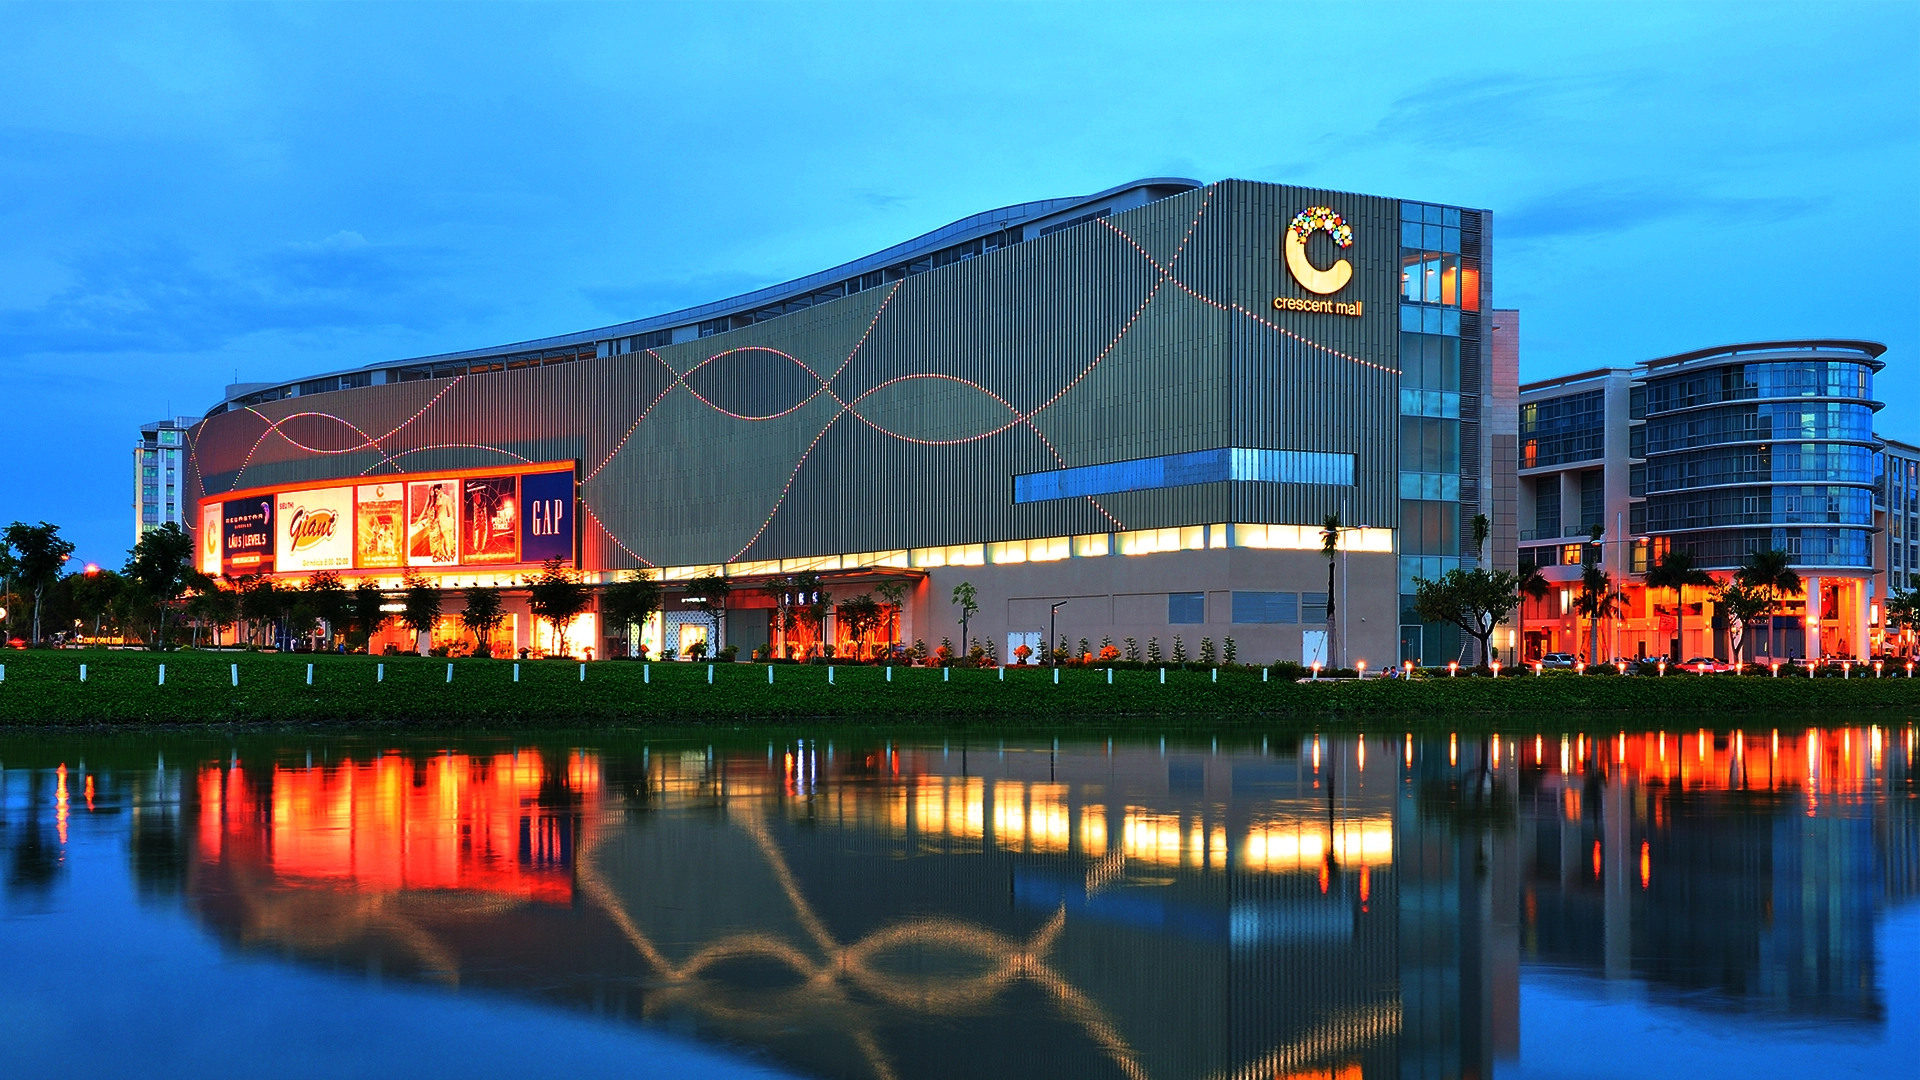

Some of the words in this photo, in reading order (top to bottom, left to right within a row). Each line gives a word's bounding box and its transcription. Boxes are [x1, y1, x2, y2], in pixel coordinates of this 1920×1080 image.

[1274, 297, 1333, 313] crescent
[1335, 300, 1363, 316] mall
[532, 499, 563, 536] GAP
[245, 533, 261, 547] LEVEL
[261, 533, 267, 545] 5
[289, 509, 335, 552] Giant
[432, 555, 456, 563] DKNY
